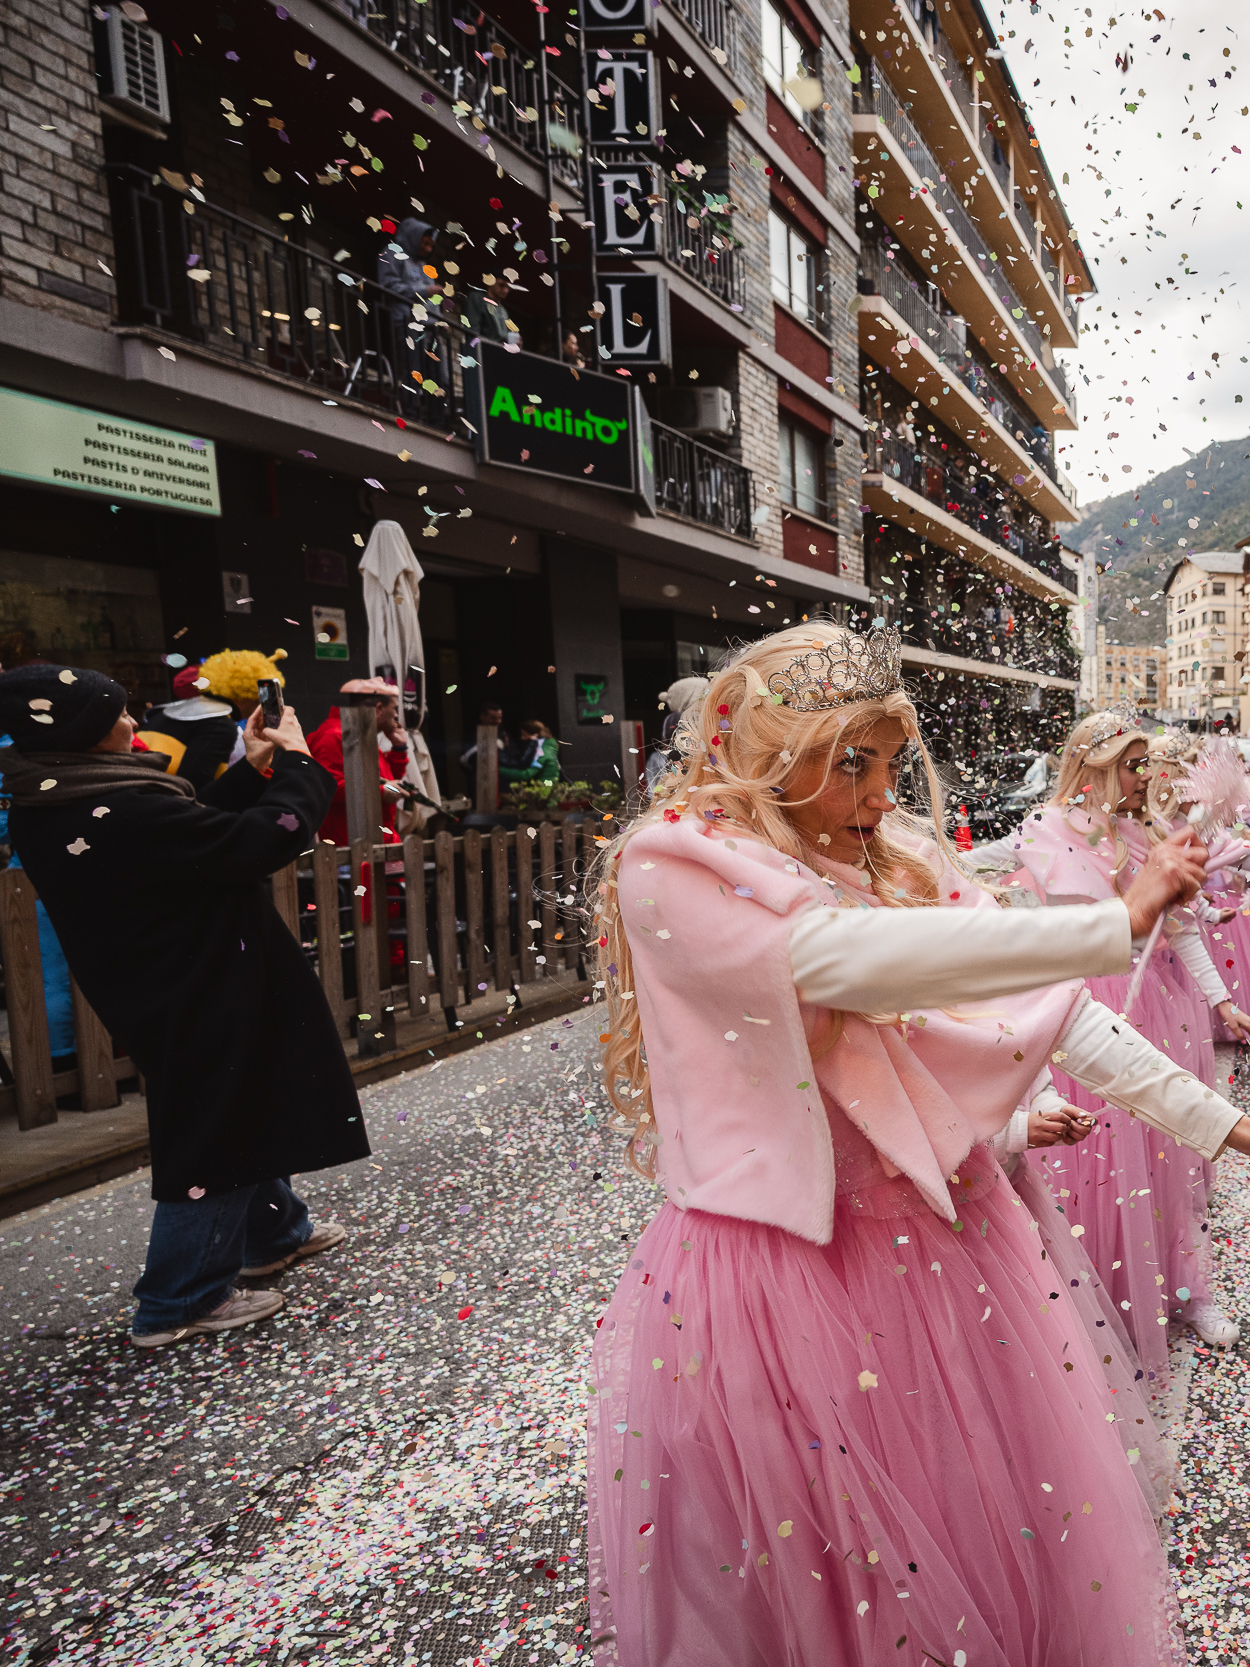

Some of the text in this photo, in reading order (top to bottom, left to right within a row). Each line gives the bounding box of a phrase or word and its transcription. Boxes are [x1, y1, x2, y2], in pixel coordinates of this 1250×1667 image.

[587, 0, 652, 355] TEL
[489, 386, 628, 444] Andino
[84, 437, 209, 474] PASTISSERIA SALADA
[97, 422, 175, 449] PASTISSERIA
[53, 467, 213, 507] PASTISSERIA PORTUGUESA
